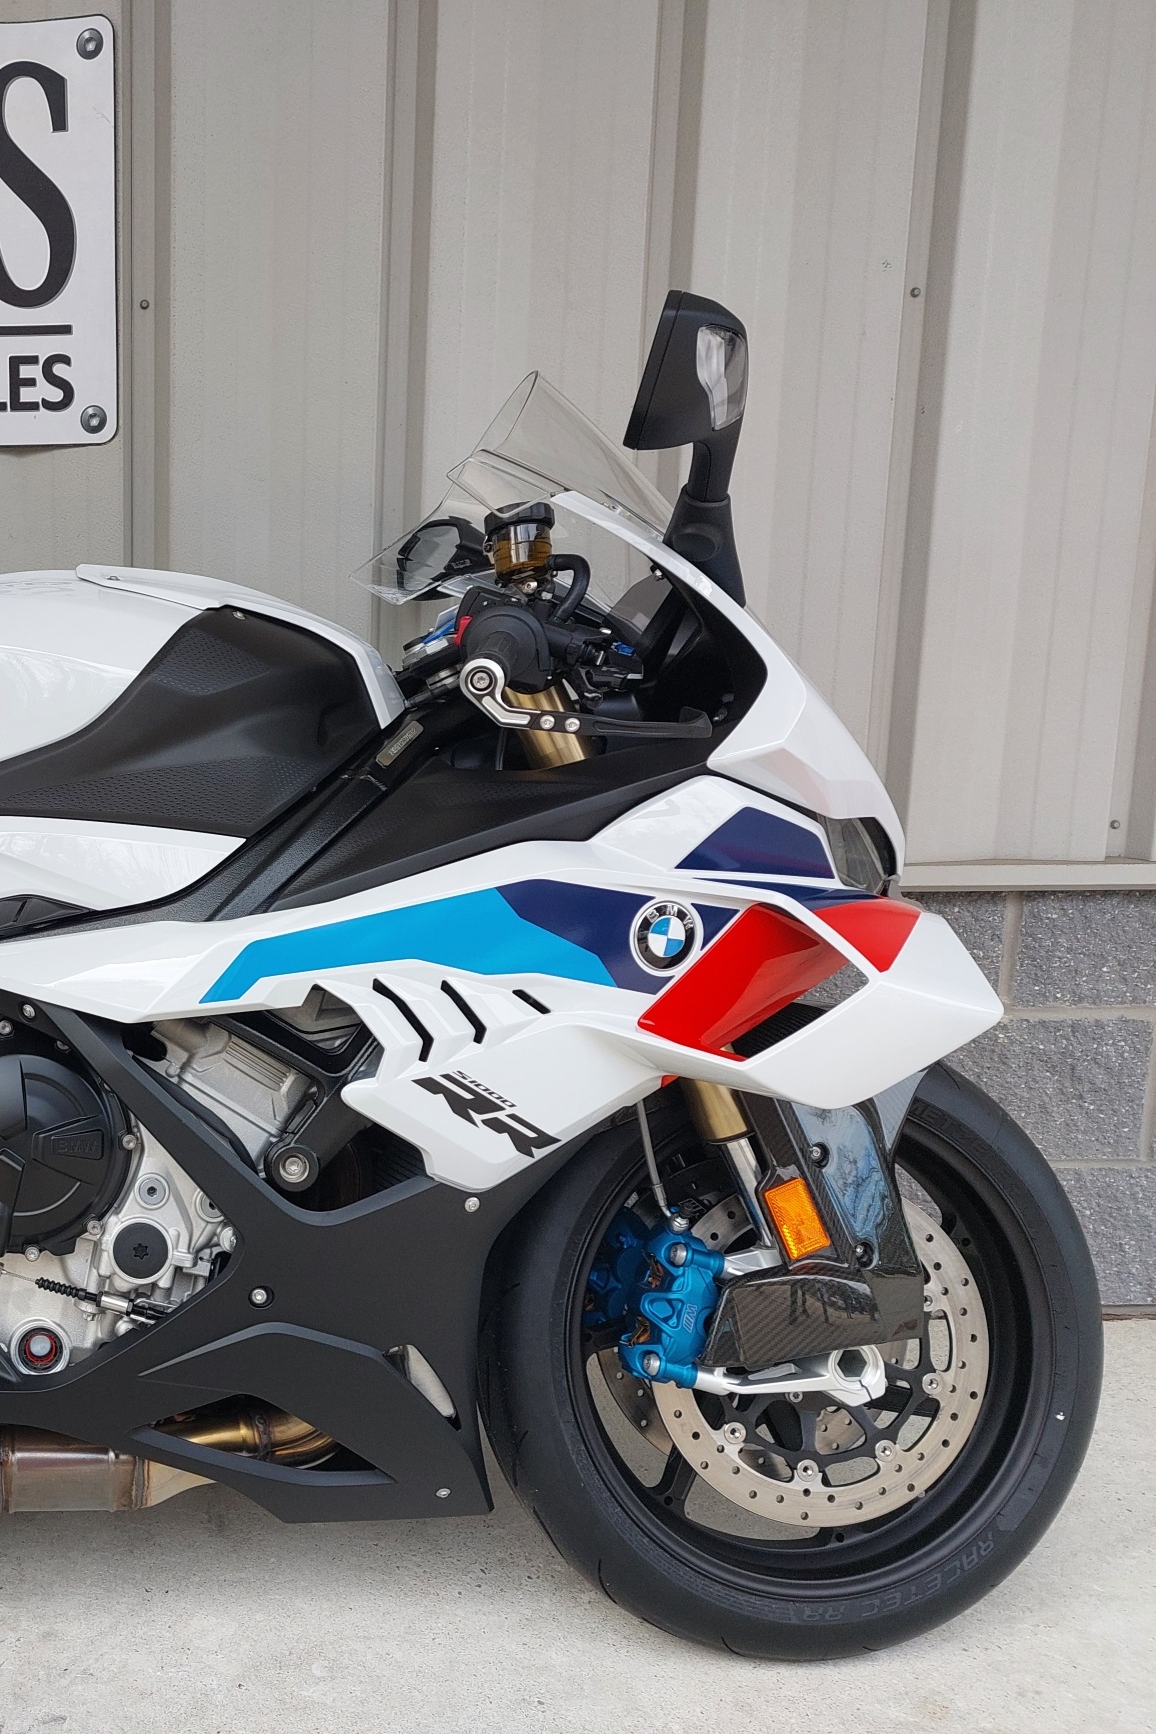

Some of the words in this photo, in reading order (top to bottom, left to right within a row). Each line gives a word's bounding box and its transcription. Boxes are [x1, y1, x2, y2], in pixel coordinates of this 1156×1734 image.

[646, 904, 695, 930] BMW
[410, 1073, 563, 1159] RR
[57, 1138, 98, 1153] BMW
[860, 1530, 996, 1618] RACETEC
